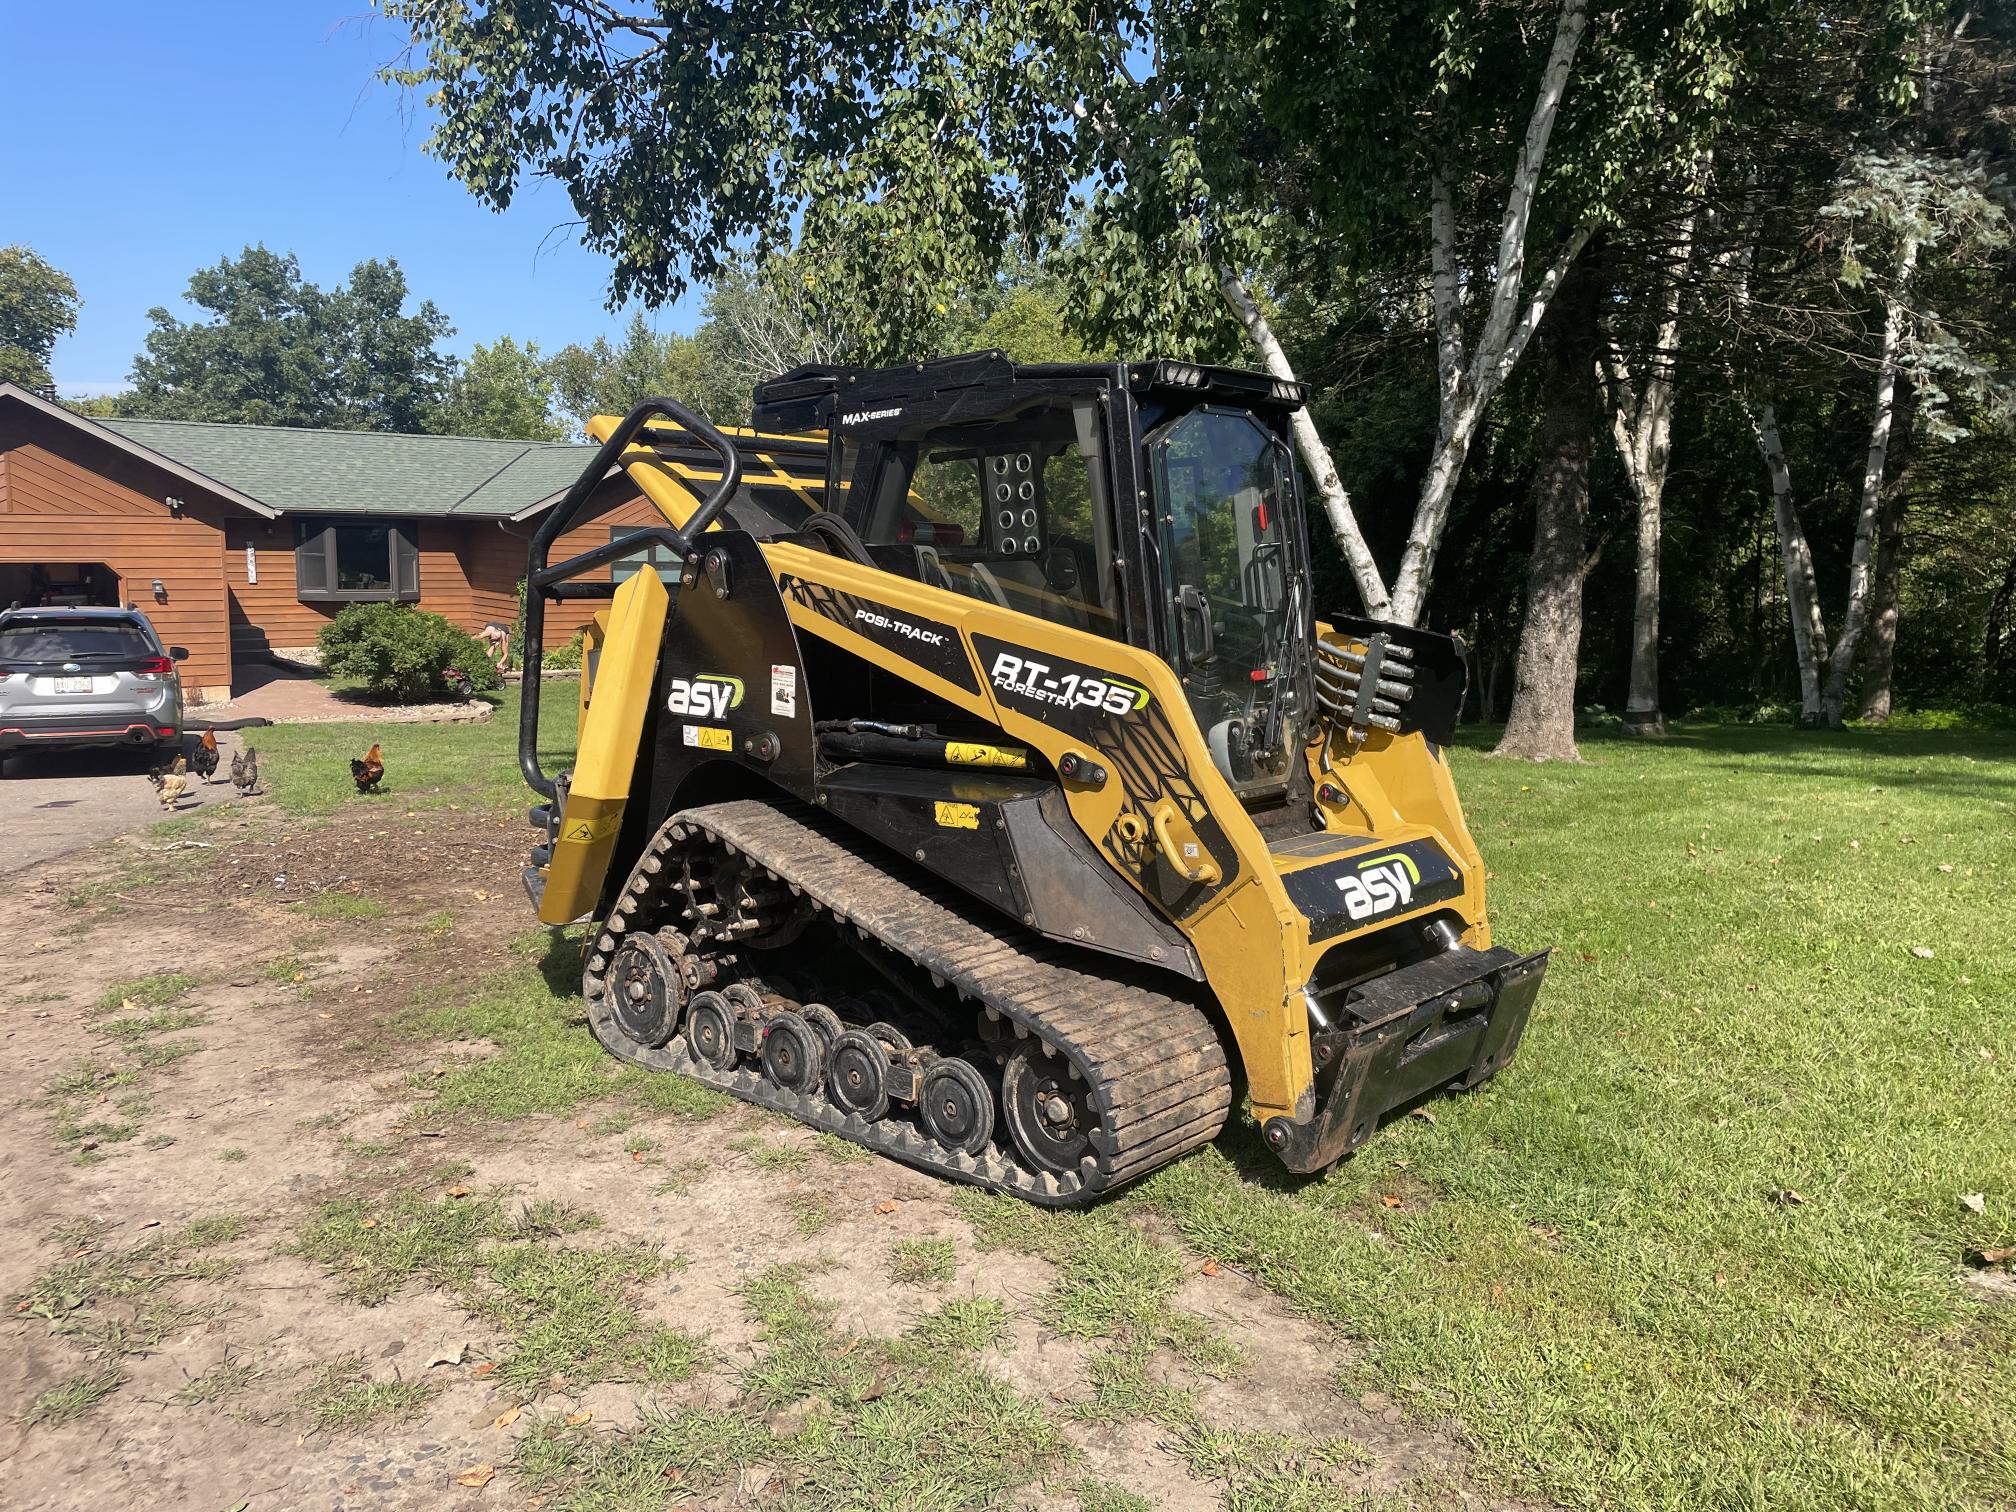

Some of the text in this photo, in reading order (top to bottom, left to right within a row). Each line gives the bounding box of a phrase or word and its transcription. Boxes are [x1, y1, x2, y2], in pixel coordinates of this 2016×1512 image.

[855, 609, 944, 646] POSI-TRACK
[991, 652, 1136, 716] RT-135
[993, 676, 1080, 710] FORESTRY
